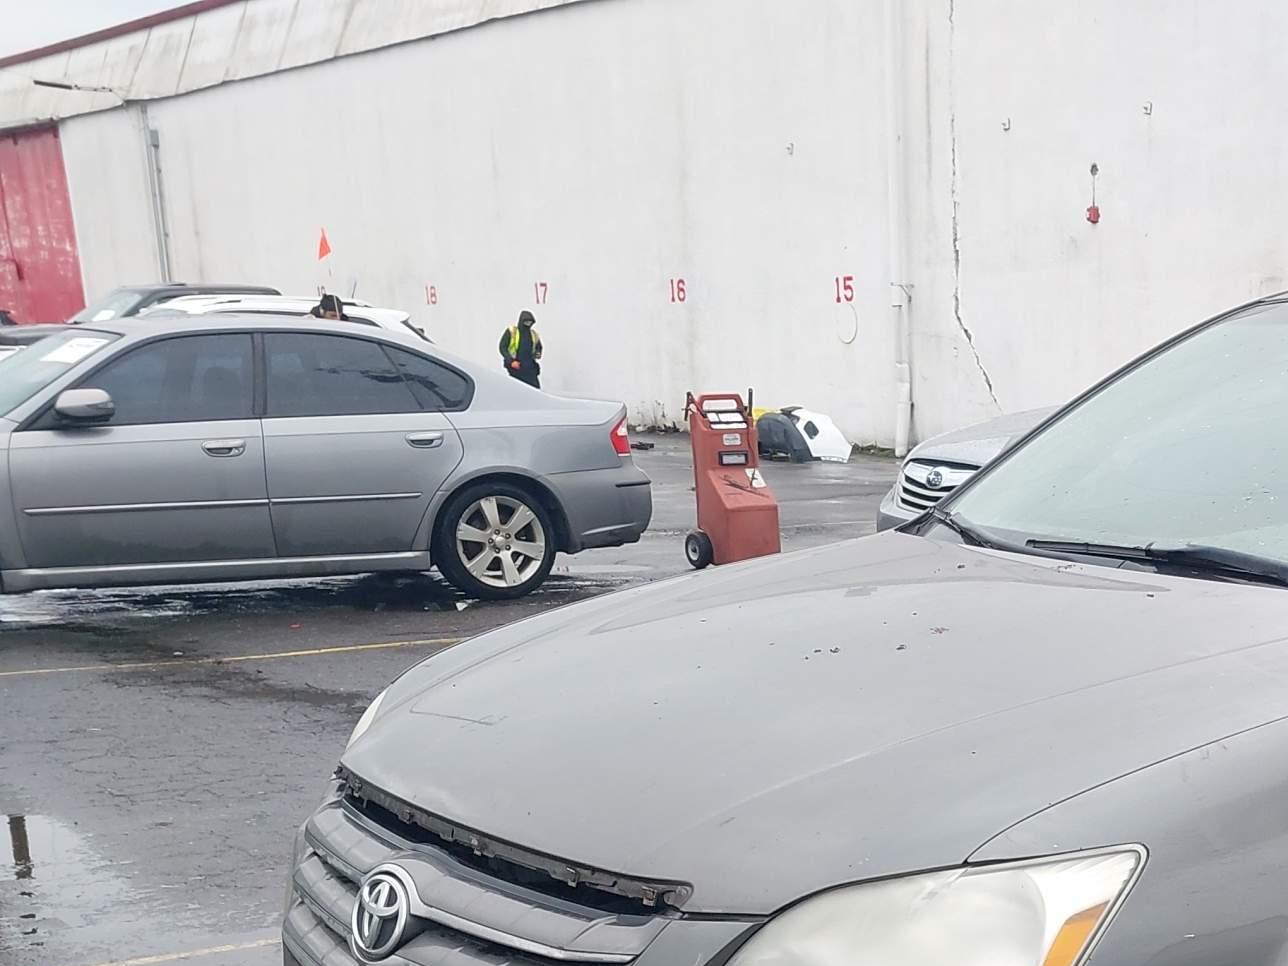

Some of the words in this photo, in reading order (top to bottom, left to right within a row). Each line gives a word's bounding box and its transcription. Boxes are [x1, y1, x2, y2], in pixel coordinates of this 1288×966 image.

[424, 285, 438, 305] 18
[534, 282, 548, 305] 17
[670, 278, 687, 303] 16
[834, 275, 854, 303] 15
